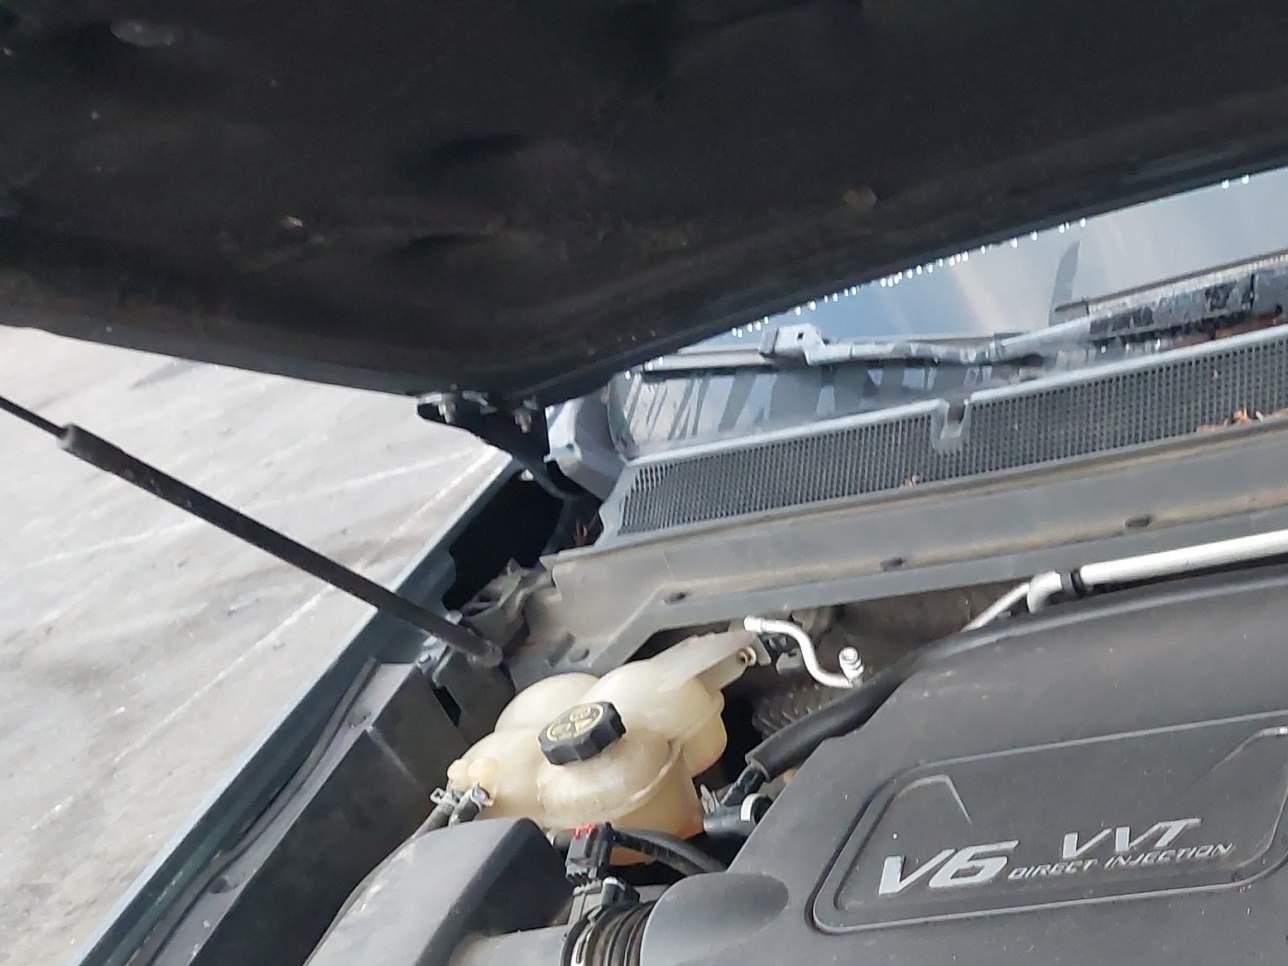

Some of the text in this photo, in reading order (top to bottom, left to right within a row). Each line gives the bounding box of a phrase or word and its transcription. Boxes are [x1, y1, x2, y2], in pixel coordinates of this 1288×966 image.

[1062, 818, 1201, 859] VVT
[878, 840, 1019, 896] V6
[1007, 843, 1234, 880] DIRECT INJECTION
